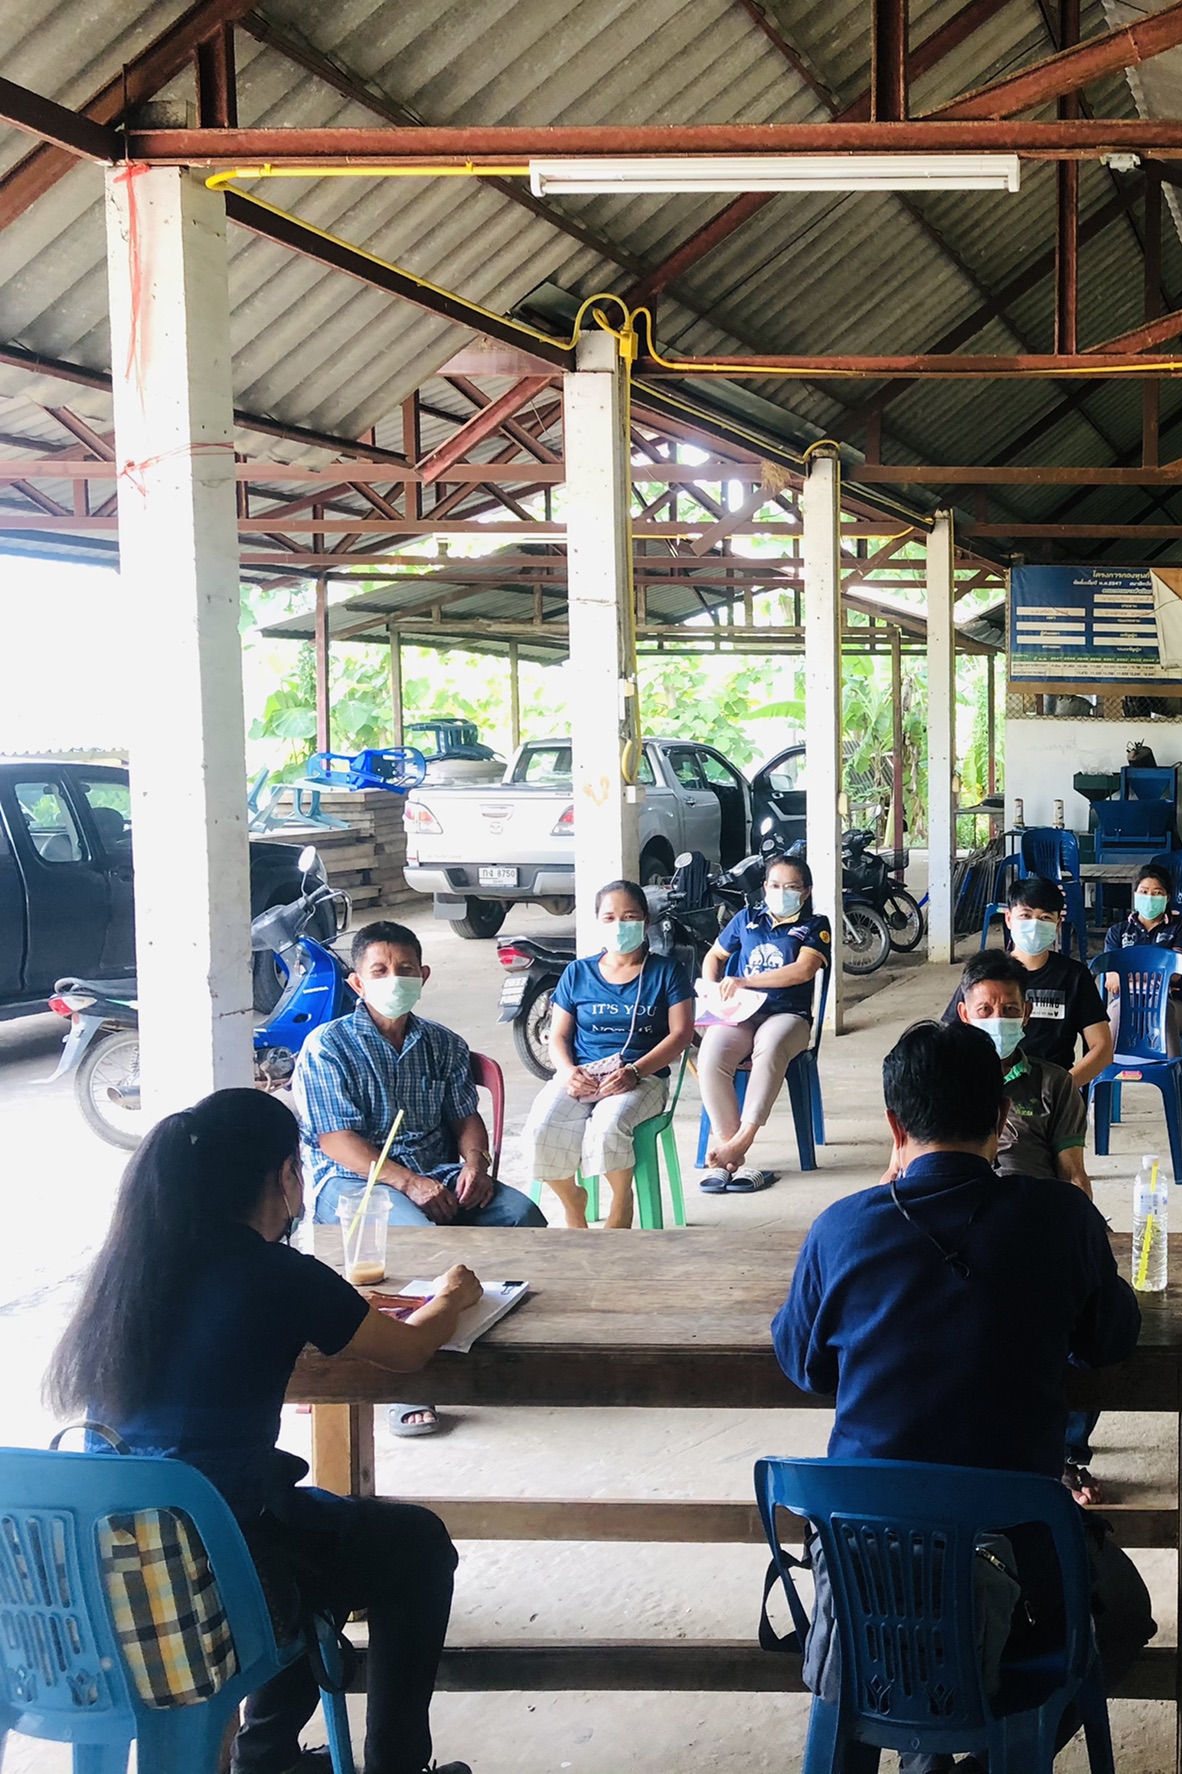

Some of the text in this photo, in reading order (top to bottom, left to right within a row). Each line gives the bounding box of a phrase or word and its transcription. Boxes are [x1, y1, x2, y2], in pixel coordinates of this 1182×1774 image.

[497, 869, 516, 878] 8750
[592, 1004, 657, 1017] IT'S YOU
